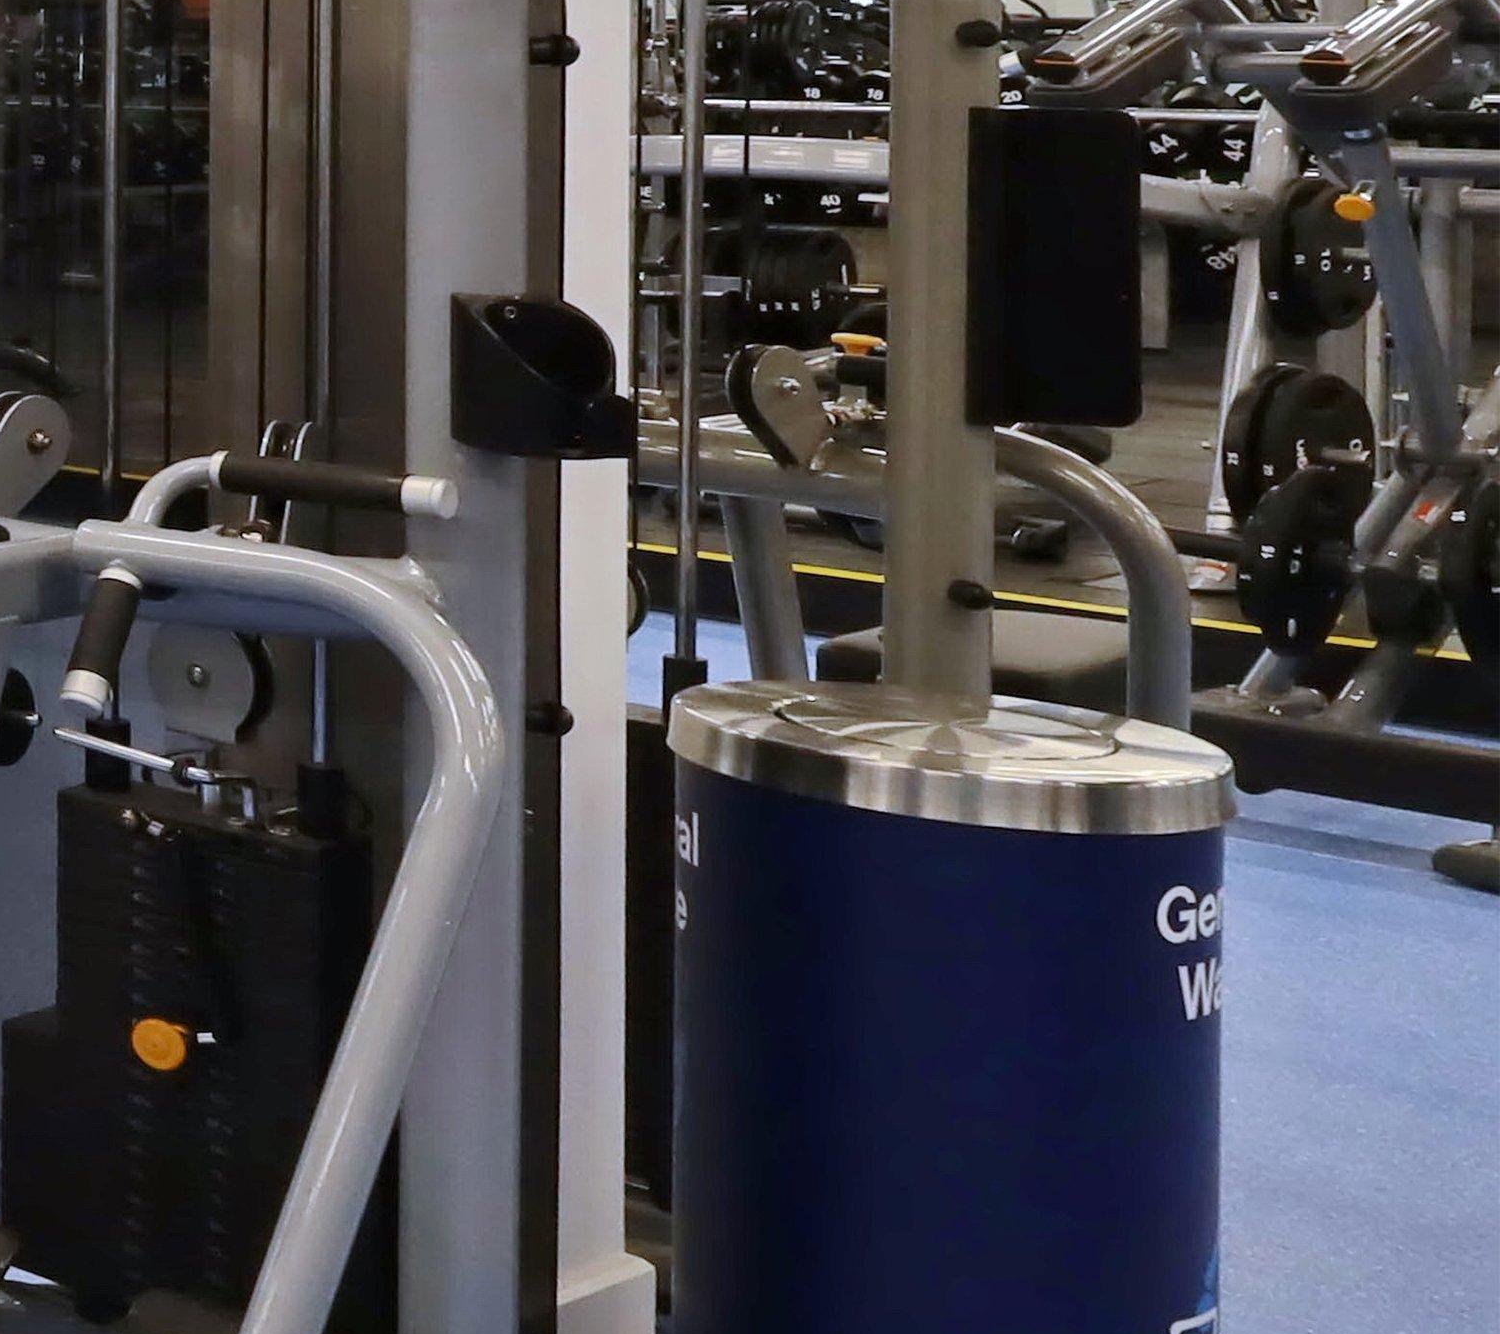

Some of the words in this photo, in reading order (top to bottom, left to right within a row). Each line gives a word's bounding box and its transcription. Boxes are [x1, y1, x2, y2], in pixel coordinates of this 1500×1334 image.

[803, 87, 821, 100] 18
[866, 88, 884, 101] 18
[1000, 90, 1023, 103] 20
